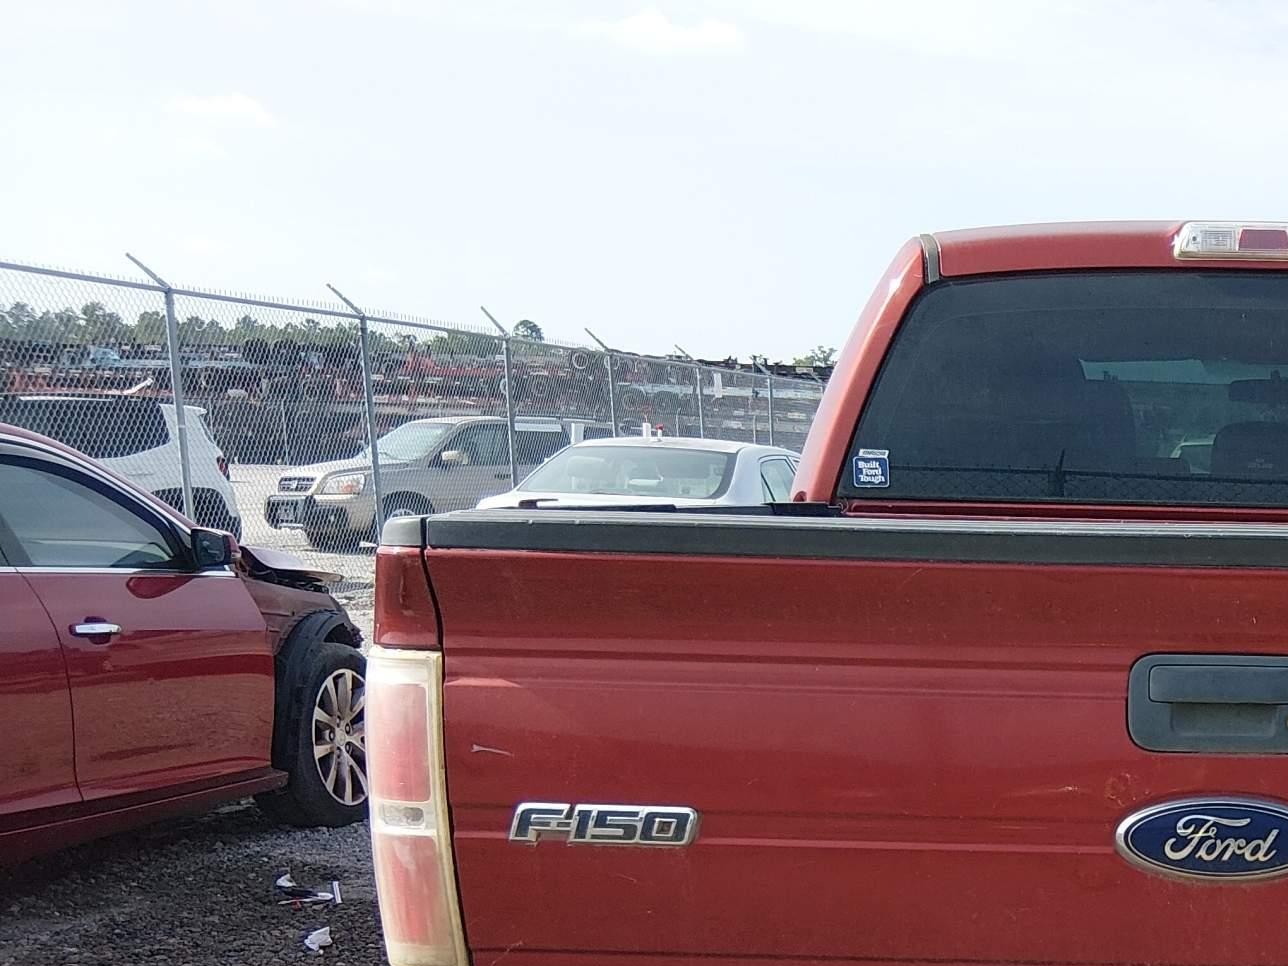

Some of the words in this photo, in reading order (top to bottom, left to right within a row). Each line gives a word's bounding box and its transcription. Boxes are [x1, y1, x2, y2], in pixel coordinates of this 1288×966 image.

[858, 460, 880, 468] Built
[863, 467, 882, 475] Ford
[859, 474, 886, 483] Tough
[509, 802, 699, 847] F-150
[1164, 814, 1279, 861] Ford
